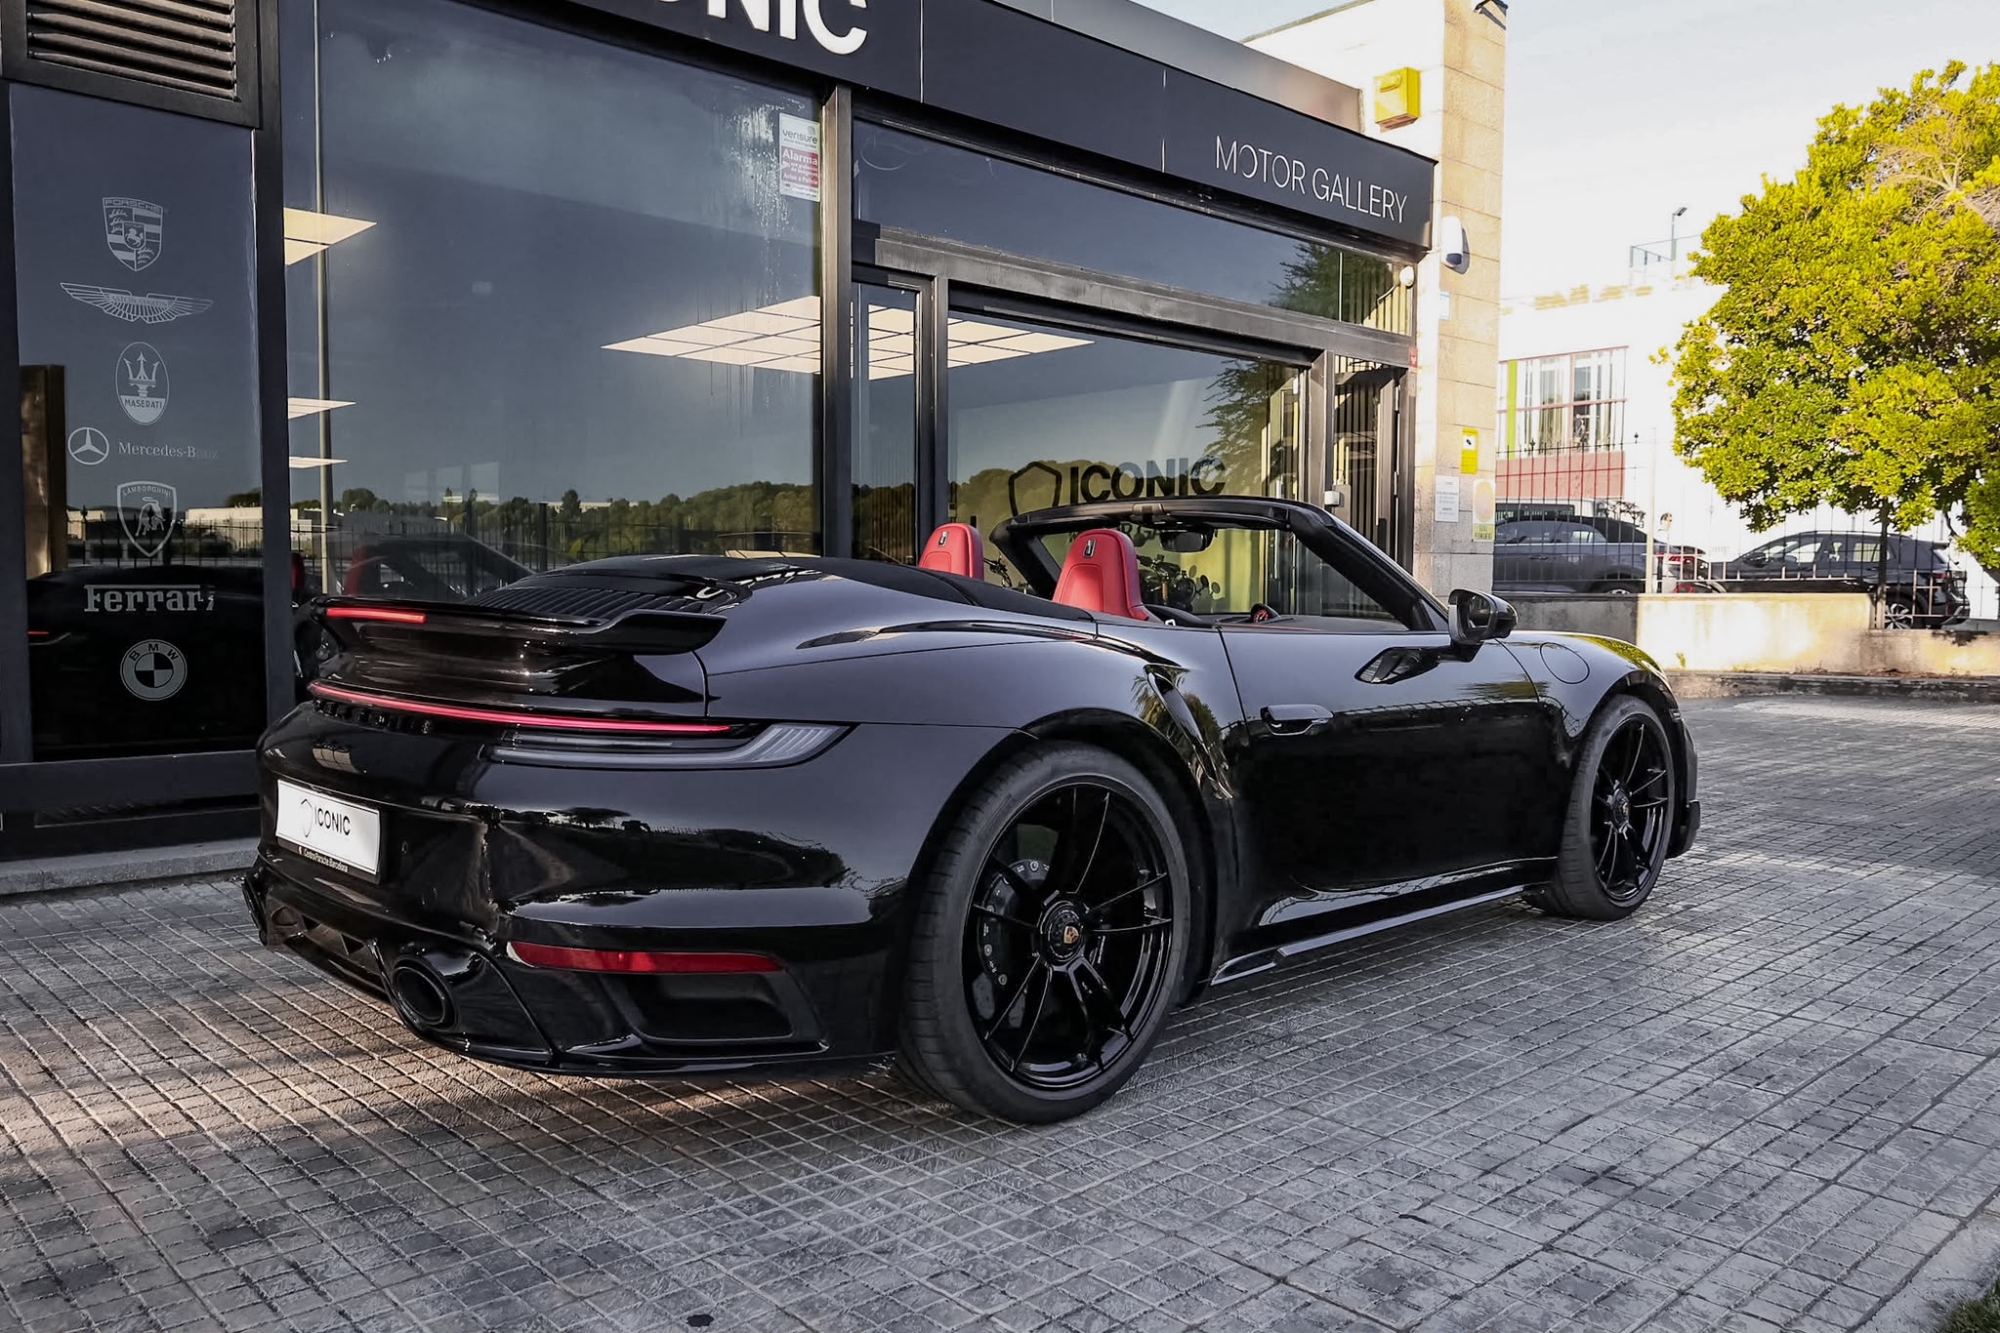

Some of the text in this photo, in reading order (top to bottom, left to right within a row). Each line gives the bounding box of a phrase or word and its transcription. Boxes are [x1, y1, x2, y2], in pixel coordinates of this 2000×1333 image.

[782, 129, 818, 145] verisure
[782, 148, 818, 166] Alarma
[1216, 135, 1408, 224] MOTOR GALLERY
[104, 199, 160, 213] PORSCHE
[125, 398, 163, 409] MASERATI
[118, 441, 218, 459] Mercedes-B
[1069, 455, 1227, 506] ICONIC
[122, 485, 173, 499] LAMBORGHINI
[129, 642, 180, 661] BMW
[314, 804, 351, 836] ICONIC
